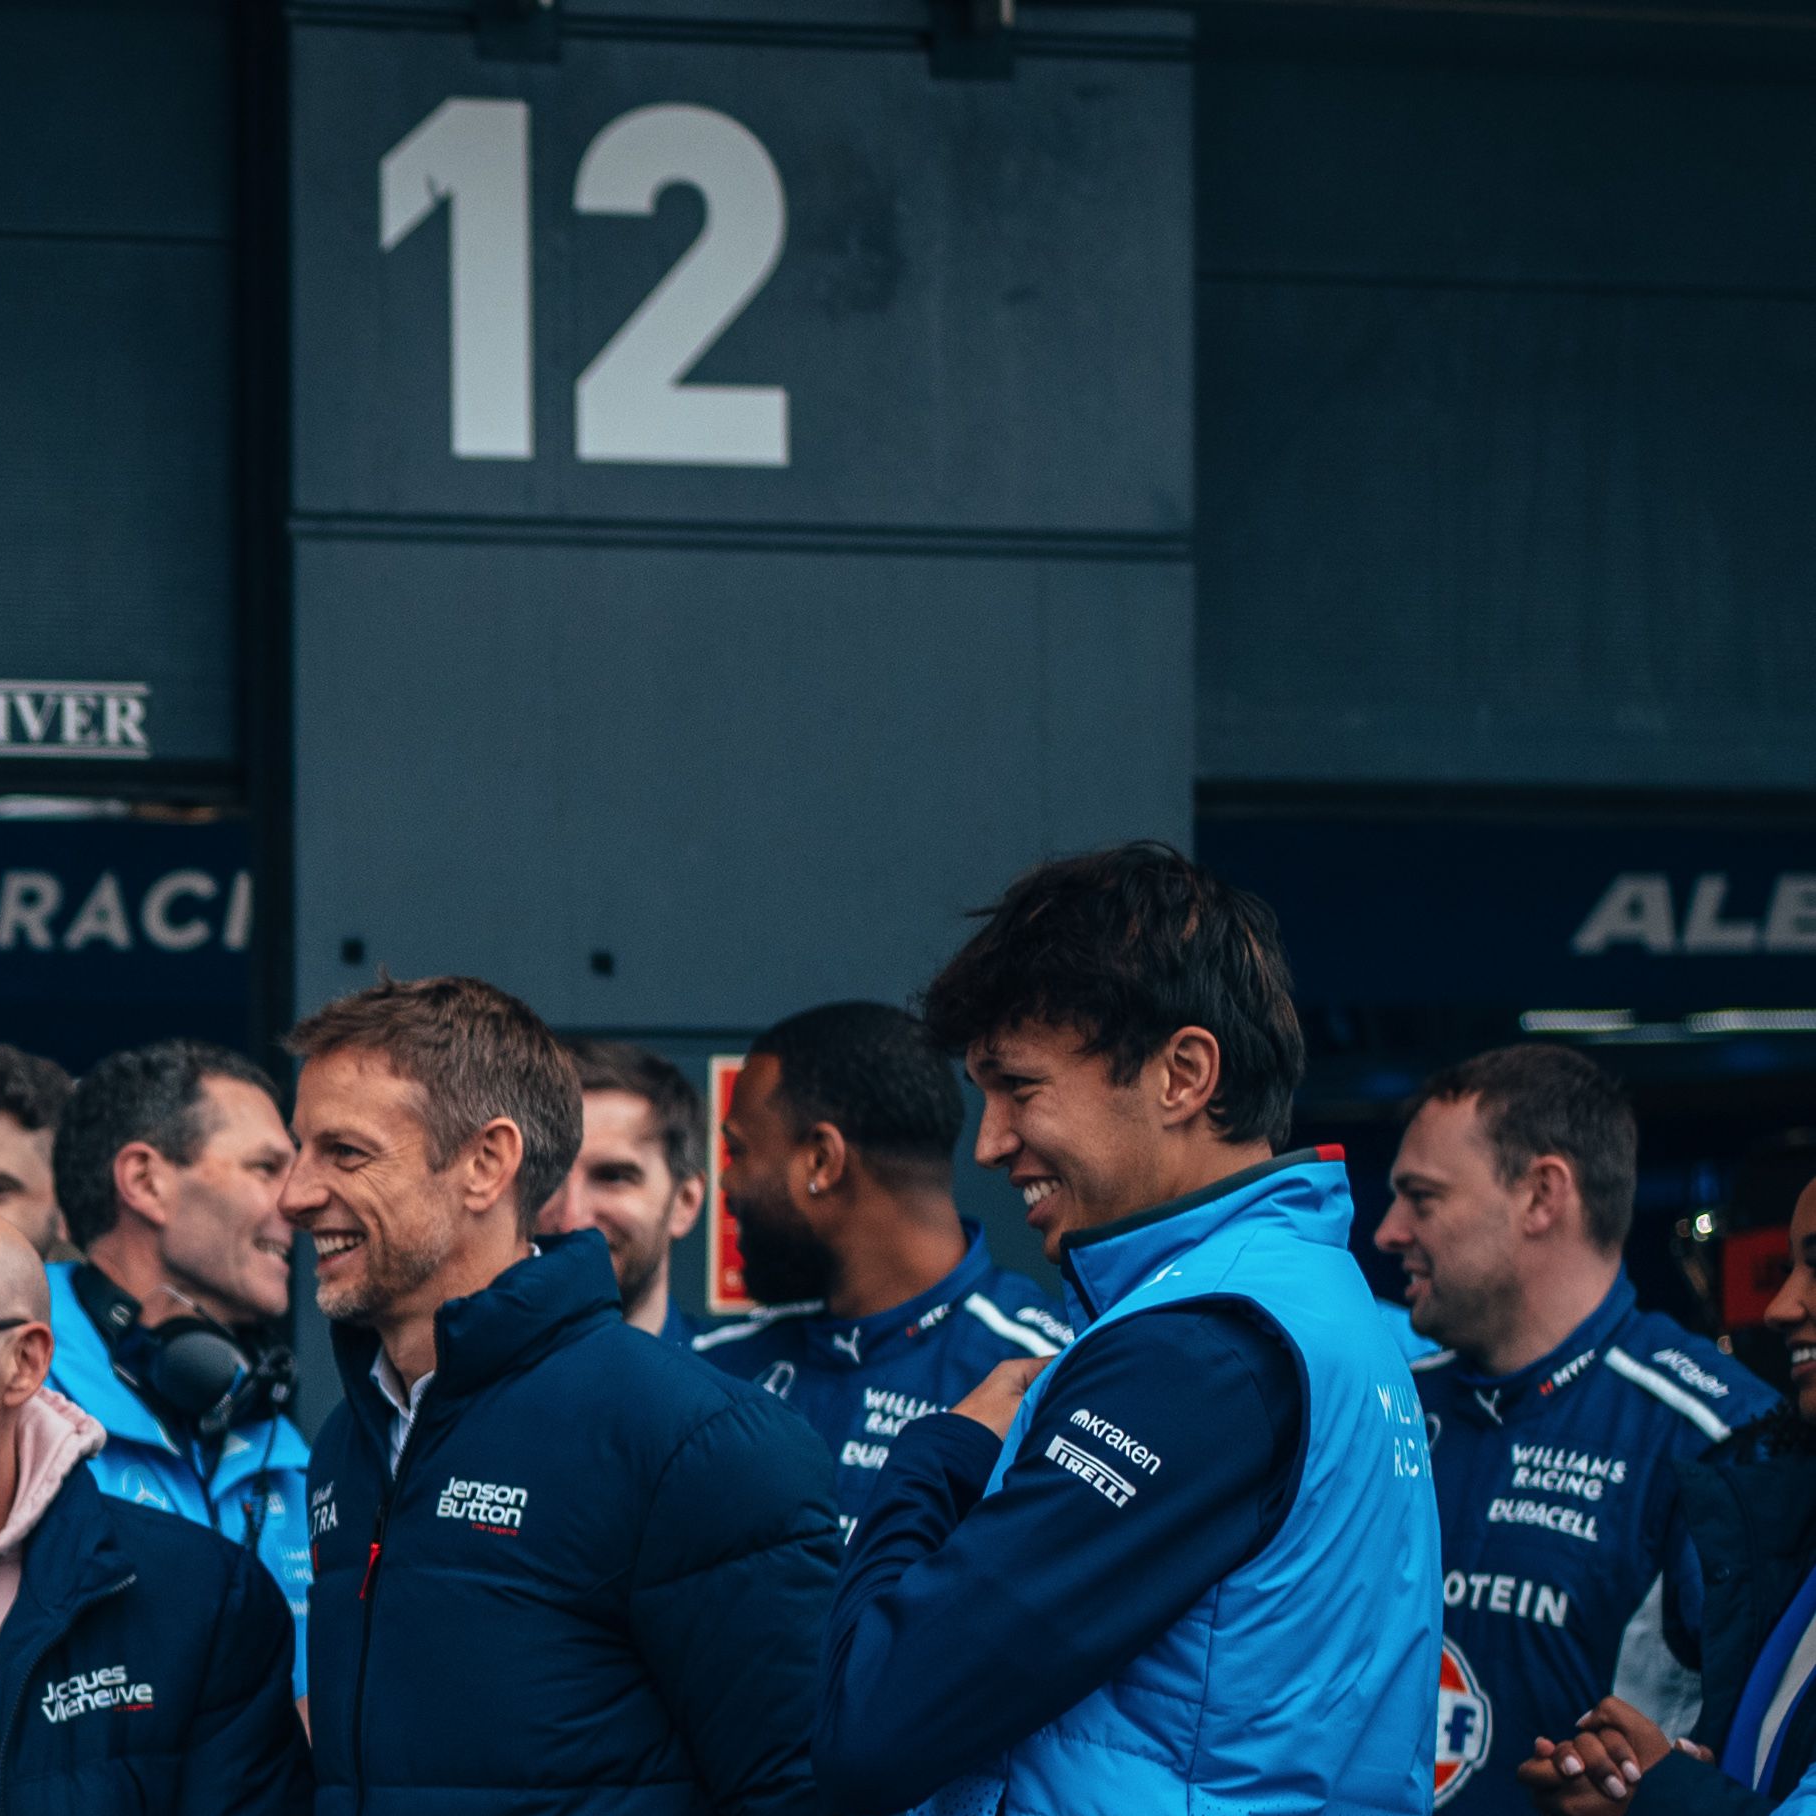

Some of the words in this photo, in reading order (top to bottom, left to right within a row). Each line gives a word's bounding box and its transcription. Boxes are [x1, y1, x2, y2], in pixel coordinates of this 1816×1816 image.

[379, 94, 789, 468] 12
[1085, 1411, 1162, 1477] kraken
[1511, 1443, 1627, 1485] WILLIAMS
[440, 1476, 529, 1508] Jenson
[1044, 1433, 1138, 1509] PIRELLI
[1512, 1465, 1604, 1502] RACING
[436, 1496, 523, 1528] Button
[1488, 1497, 1599, 1543] DURACELL
[42, 1664, 127, 1703] Jcques
